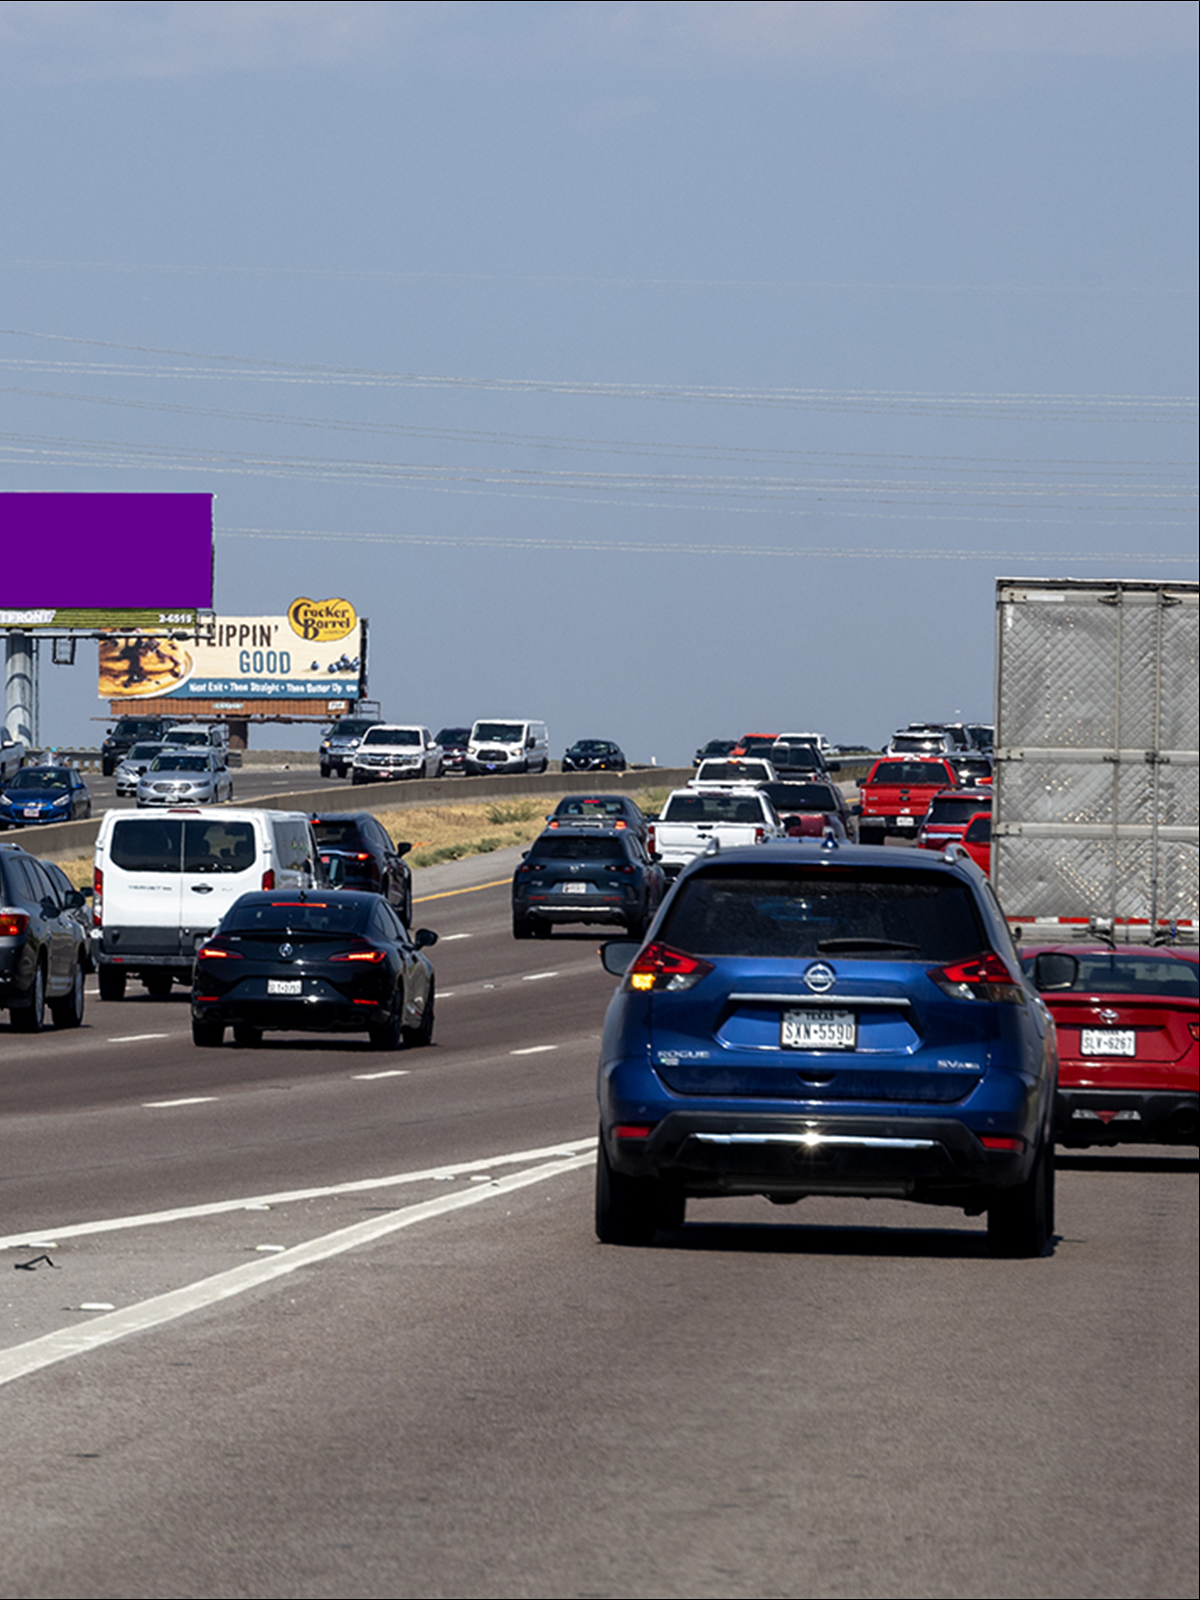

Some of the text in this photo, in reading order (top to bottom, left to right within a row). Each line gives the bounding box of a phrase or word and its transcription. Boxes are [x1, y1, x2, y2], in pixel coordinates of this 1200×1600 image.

[293, 602, 349, 628] Cracker
[303, 618, 350, 640] Barrel
[239, 650, 291, 674] GOOD
[189, 682, 207, 692] Next
[208, 682, 224, 692] Exit
[230, 682, 249, 692] Then
[286, 683, 305, 693] Then
[657, 1050, 711, 1059] ROGUE
